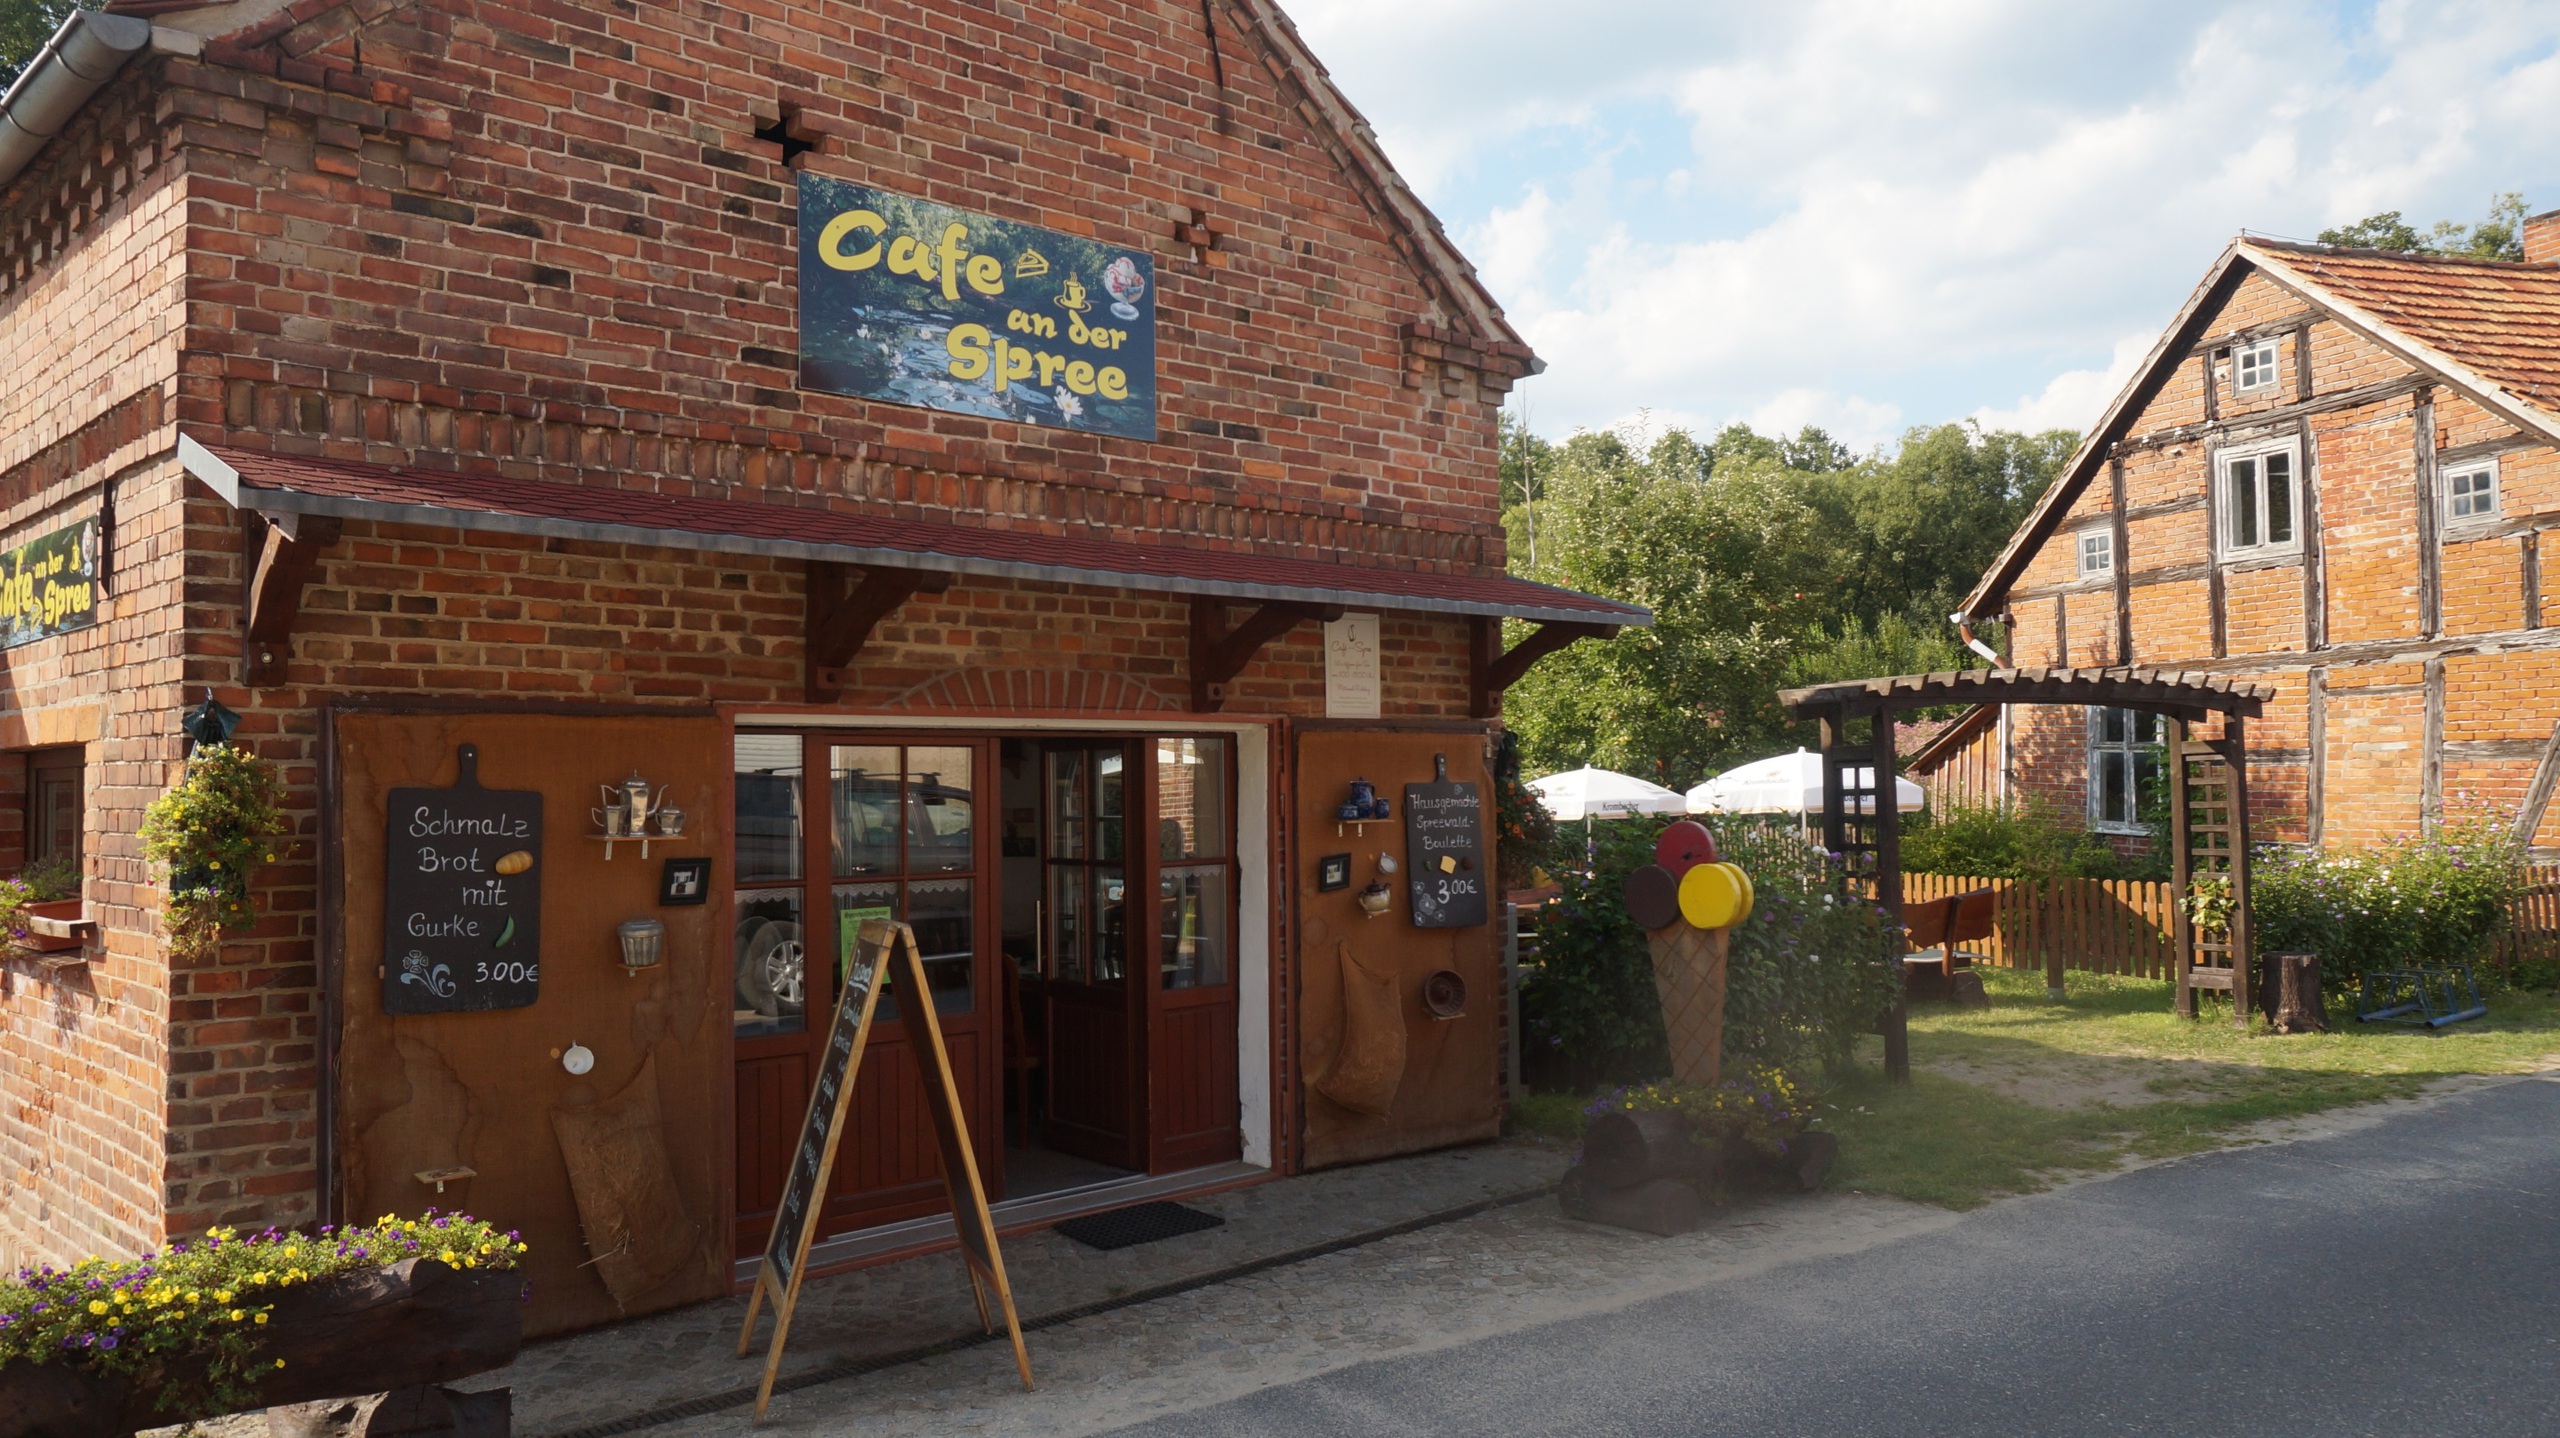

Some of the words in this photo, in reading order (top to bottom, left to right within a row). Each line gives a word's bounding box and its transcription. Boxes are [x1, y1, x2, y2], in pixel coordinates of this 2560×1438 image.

[818, 210, 1005, 301] Cafe
[1007, 309, 1057, 339] an
[1068, 310, 1127, 350] der
[946, 323, 1128, 400] Spree
[35, 561, 46, 579] an
[48, 549, 64, 576] der
[0, 548, 34, 633] afe
[44, 579, 91, 628] Spree
[1422, 835, 1473, 850] Boulette
[418, 847, 486, 872] Brot
[463, 880, 508, 906] mit
[408, 913, 481, 937] Gurke
[475, 962, 539, 983] 3.00€
